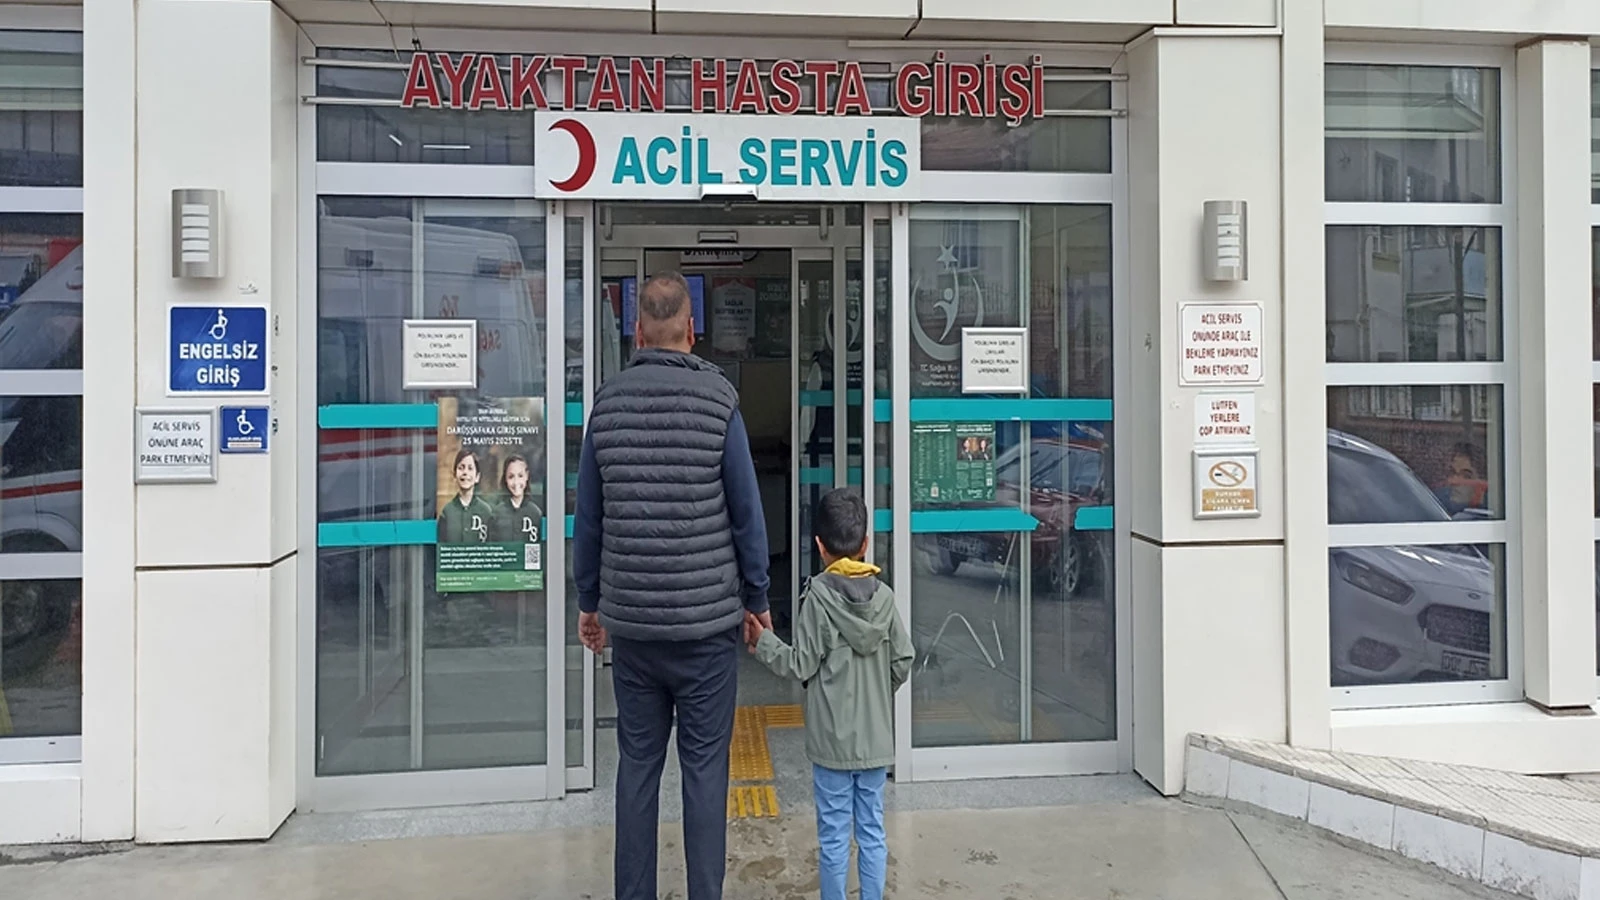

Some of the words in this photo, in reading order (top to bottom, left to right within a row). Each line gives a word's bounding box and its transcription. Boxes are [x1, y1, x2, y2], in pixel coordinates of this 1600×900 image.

[401, 51, 666, 111] AYAKTAN
[691, 57, 873, 115] HASTA
[897, 50, 1044, 127] GİRİŞİ
[612, 125, 723, 185] ACİL
[739, 128, 909, 187] SERVİS
[179, 339, 259, 359] ENGELSİZ
[1186, 347, 1215, 359] BEKLEME
[1217, 347, 1259, 358] YAPMAYINIZ
[1194, 364, 1211, 375] PARK
[196, 363, 241, 388] GİRİŞ
[1210, 412, 1240, 423] YERLERE
[516, 426, 539, 434] SINAVI
[463, 437, 472, 445] 25
[473, 437, 494, 445] MAYIS
[140, 454, 162, 464] PARK
